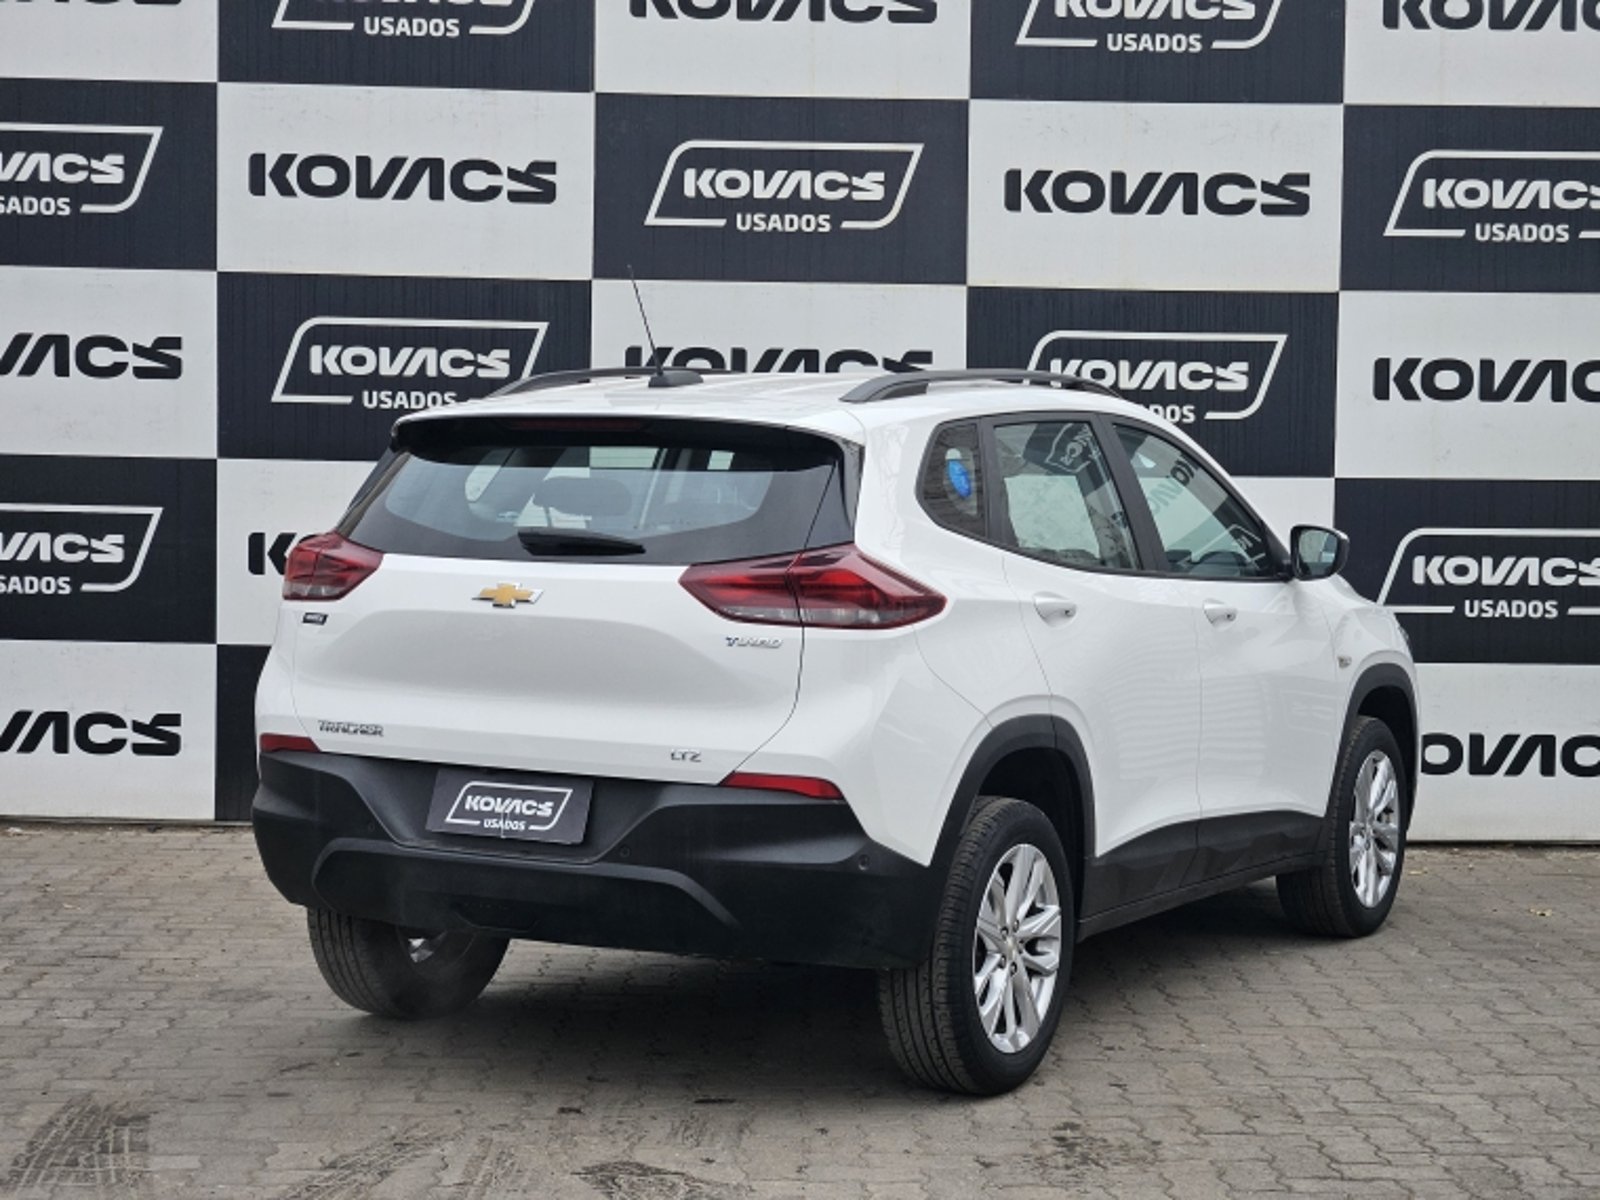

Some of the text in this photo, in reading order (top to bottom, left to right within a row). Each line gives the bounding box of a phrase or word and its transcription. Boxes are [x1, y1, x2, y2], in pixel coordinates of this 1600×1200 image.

[1054, 0, 1256, 20] KOVACS
[363, 16, 460, 37] USADOS
[1106, 33, 1203, 53] USADOS
[248, 152, 557, 205] KOVACS
[683, 168, 885, 201] KOVACS
[1004, 168, 1311, 217] KOVACS
[736, 212, 832, 233] USADOS
[1475, 222, 1570, 243] USADOS
[309, 344, 510, 379] KOVACS
[362, 390, 457, 410] USADOS
[1141, 404, 1196, 424] DOS
[1464, 599, 1559, 619] USADOS
[670, 750, 702, 763] LTZ
[464, 795, 554, 818] KOVACS
[483, 818, 527, 831] USADOS
